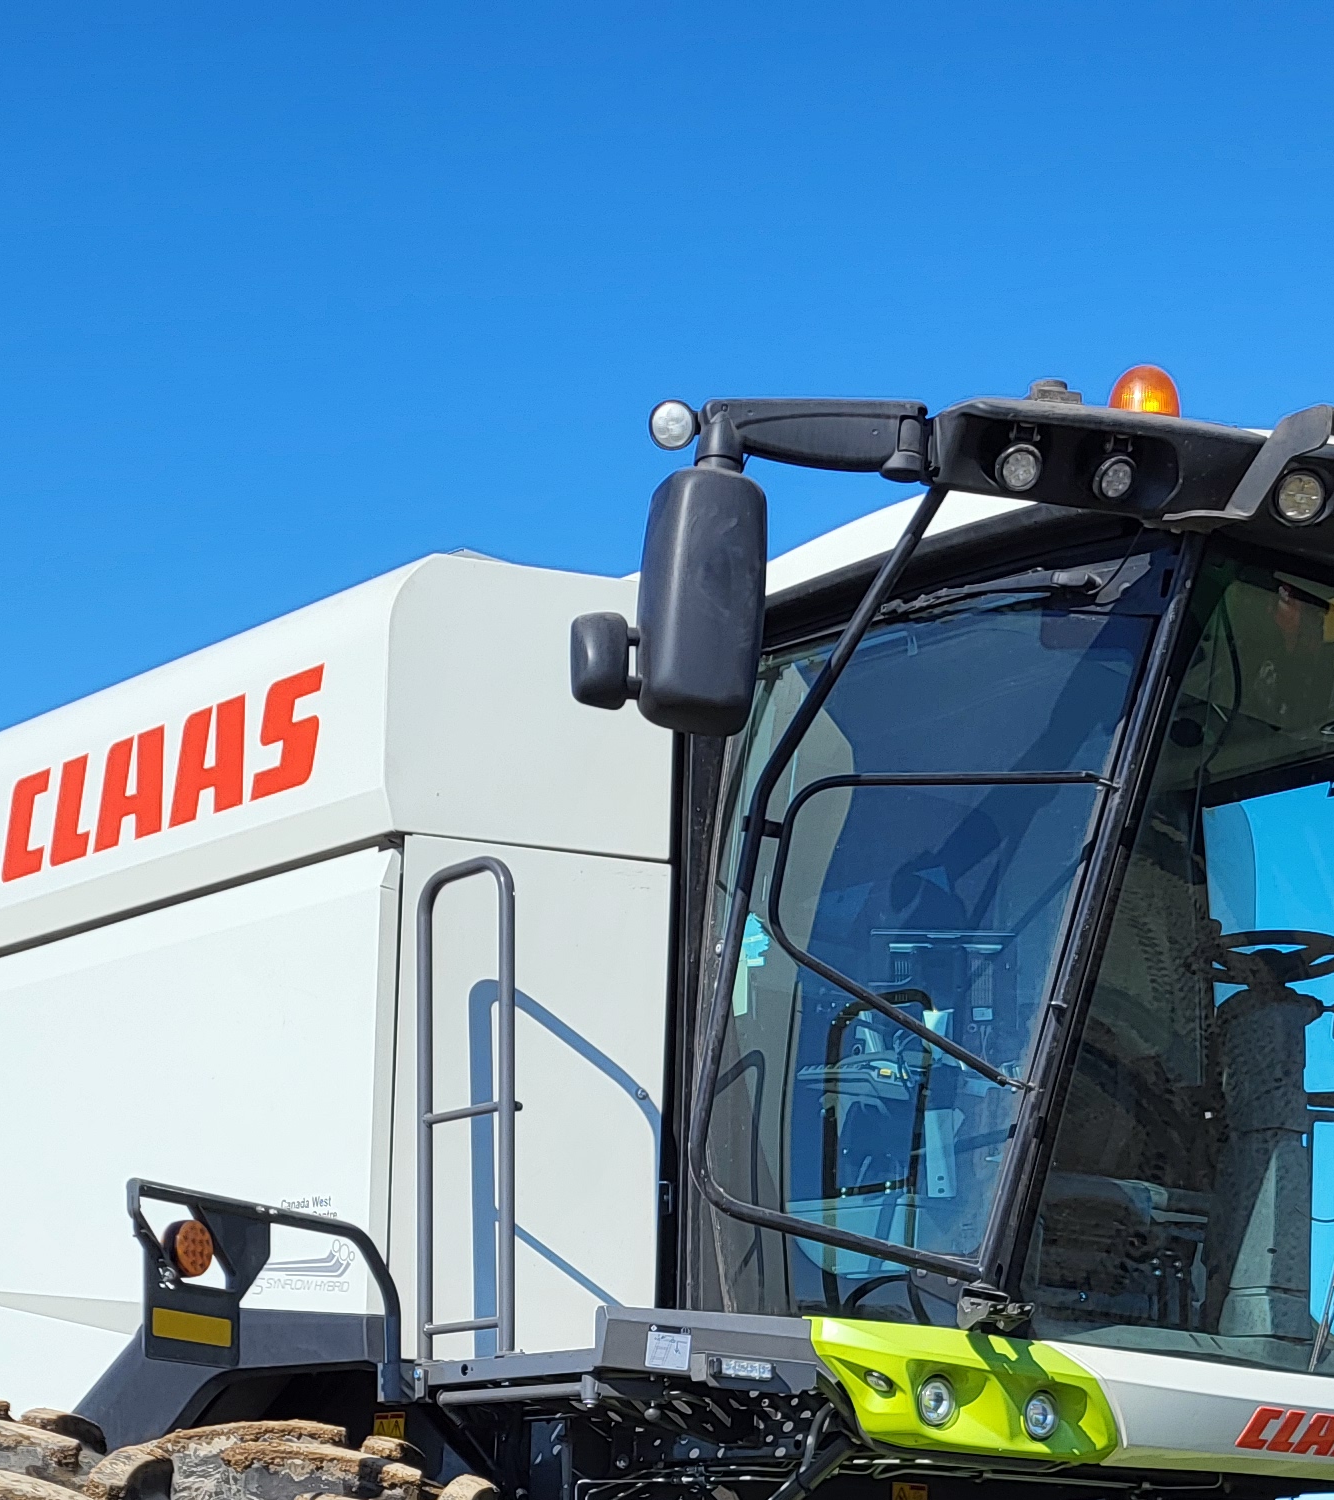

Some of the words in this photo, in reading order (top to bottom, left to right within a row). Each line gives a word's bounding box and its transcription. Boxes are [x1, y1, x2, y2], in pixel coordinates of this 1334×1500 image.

[1, 663, 325, 883] CLAAS
[280, 1198, 310, 1211] Canada
[311, 1195, 332, 1208] West
[265, 1277, 313, 1291] SYNFLOW
[314, 1281, 350, 1293] HYBRID
